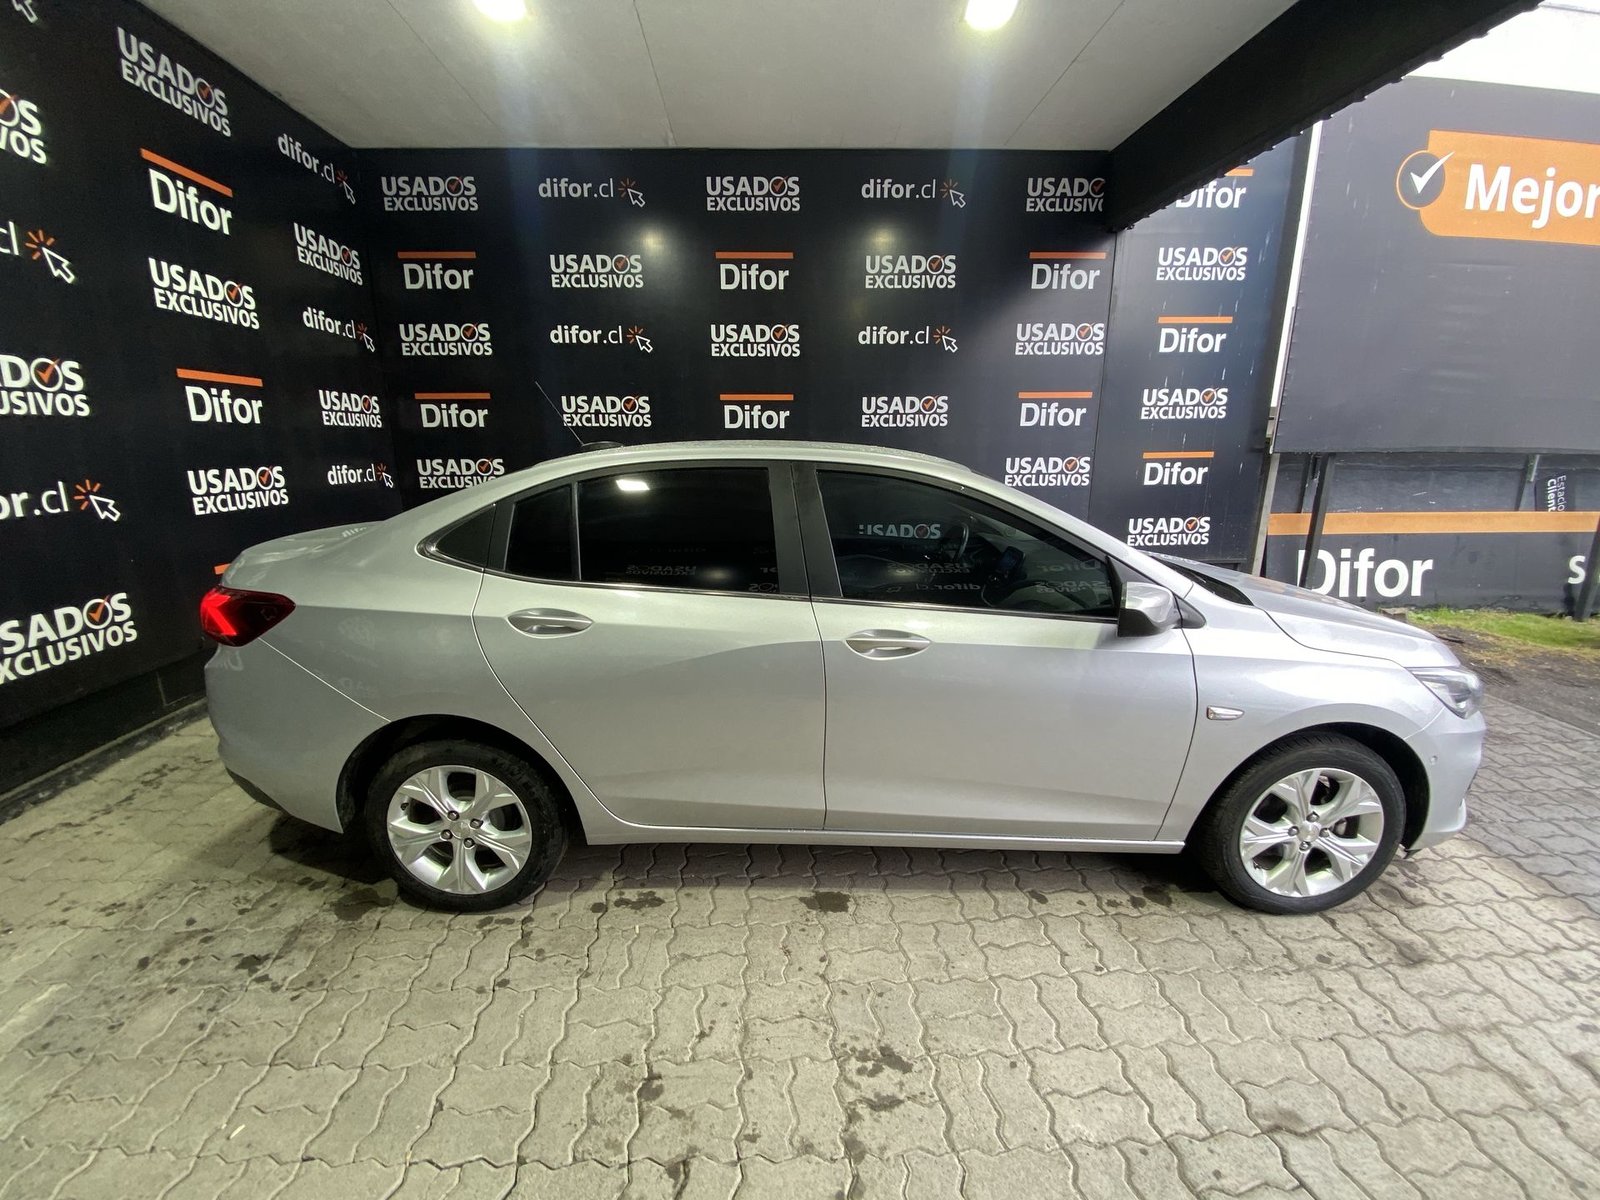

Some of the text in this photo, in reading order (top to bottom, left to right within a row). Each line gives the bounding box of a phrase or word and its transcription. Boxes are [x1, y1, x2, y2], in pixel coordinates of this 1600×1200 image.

[117, 27, 228, 116] USADOS
[120, 59, 232, 137] EXCLUSIVOS
[277, 134, 336, 185] difor.cl
[381, 176, 477, 197] USADOS
[538, 178, 614, 198] difor.cl
[706, 176, 800, 197] USADOS
[861, 178, 936, 199] difor.cl
[1464, 163, 1600, 229] Mejor
[148, 169, 233, 235] Difor
[384, 197, 479, 211] EXCLUSIVOS
[706, 197, 800, 212] EXCLUSIVOS
[1026, 198, 1103, 212] EXCLUSIV
[293, 222, 361, 270] USADOS
[297, 246, 363, 286] EXCLUSIVOS
[549, 254, 642, 274] USADOS
[866, 254, 956, 275] USADOS
[1159, 247, 1248, 266] USADOS
[148, 257, 256, 310] USADOS
[402, 263, 474, 290] Difor
[551, 274, 644, 289] EXCLUSIVOS
[720, 263, 789, 290] Difor
[865, 275, 956, 289] EXCLUSIVOS
[1031, 264, 1100, 290] Difor
[1156, 267, 1246, 281] EXCLUSIVOS
[153, 288, 259, 329] EXCLUSIVOS
[302, 307, 356, 340] difor.cl
[399, 323, 491, 342] USADOS
[711, 323, 800, 343] USADOS
[1016, 322, 1105, 342] USADOS
[550, 325, 623, 344] difor.cl
[857, 326, 929, 345] difor.cl
[1158, 328, 1227, 353] Difor
[401, 342, 493, 356] EXCLUSIVOS
[711, 343, 800, 357] EXCLUSIVOS
[1015, 341, 1104, 356] EXCLUSIVOS
[184, 386, 263, 424] Difor
[319, 389, 380, 414] USADOS
[561, 395, 651, 414] USADOS
[861, 395, 948, 414] USADOS
[1143, 388, 1228, 407] USADOS
[322, 411, 382, 429] EXCLUSIVOS
[420, 403, 489, 428] Difor
[563, 413, 652, 428] EXCLUSIVOS
[724, 404, 790, 430] Difor
[861, 413, 948, 428] EXCLUSIVOS
[1019, 402, 1087, 427] Difor
[1141, 405, 1227, 420] EXCLUSIVOS
[327, 463, 376, 486] difor.cl
[416, 458, 505, 476] USADOS
[1005, 456, 1091, 474] USADOS
[1143, 462, 1209, 486] Difor
[187, 465, 286, 495] USADOS
[1004, 472, 1090, 487] EXCLUSIVOS
[192, 489, 289, 516] EXCLUSIVOS
[1128, 516, 1211, 534] USADOS
[1127, 532, 1210, 547] EXCLUSIVOS
[1297, 548, 1434, 597] Difor
